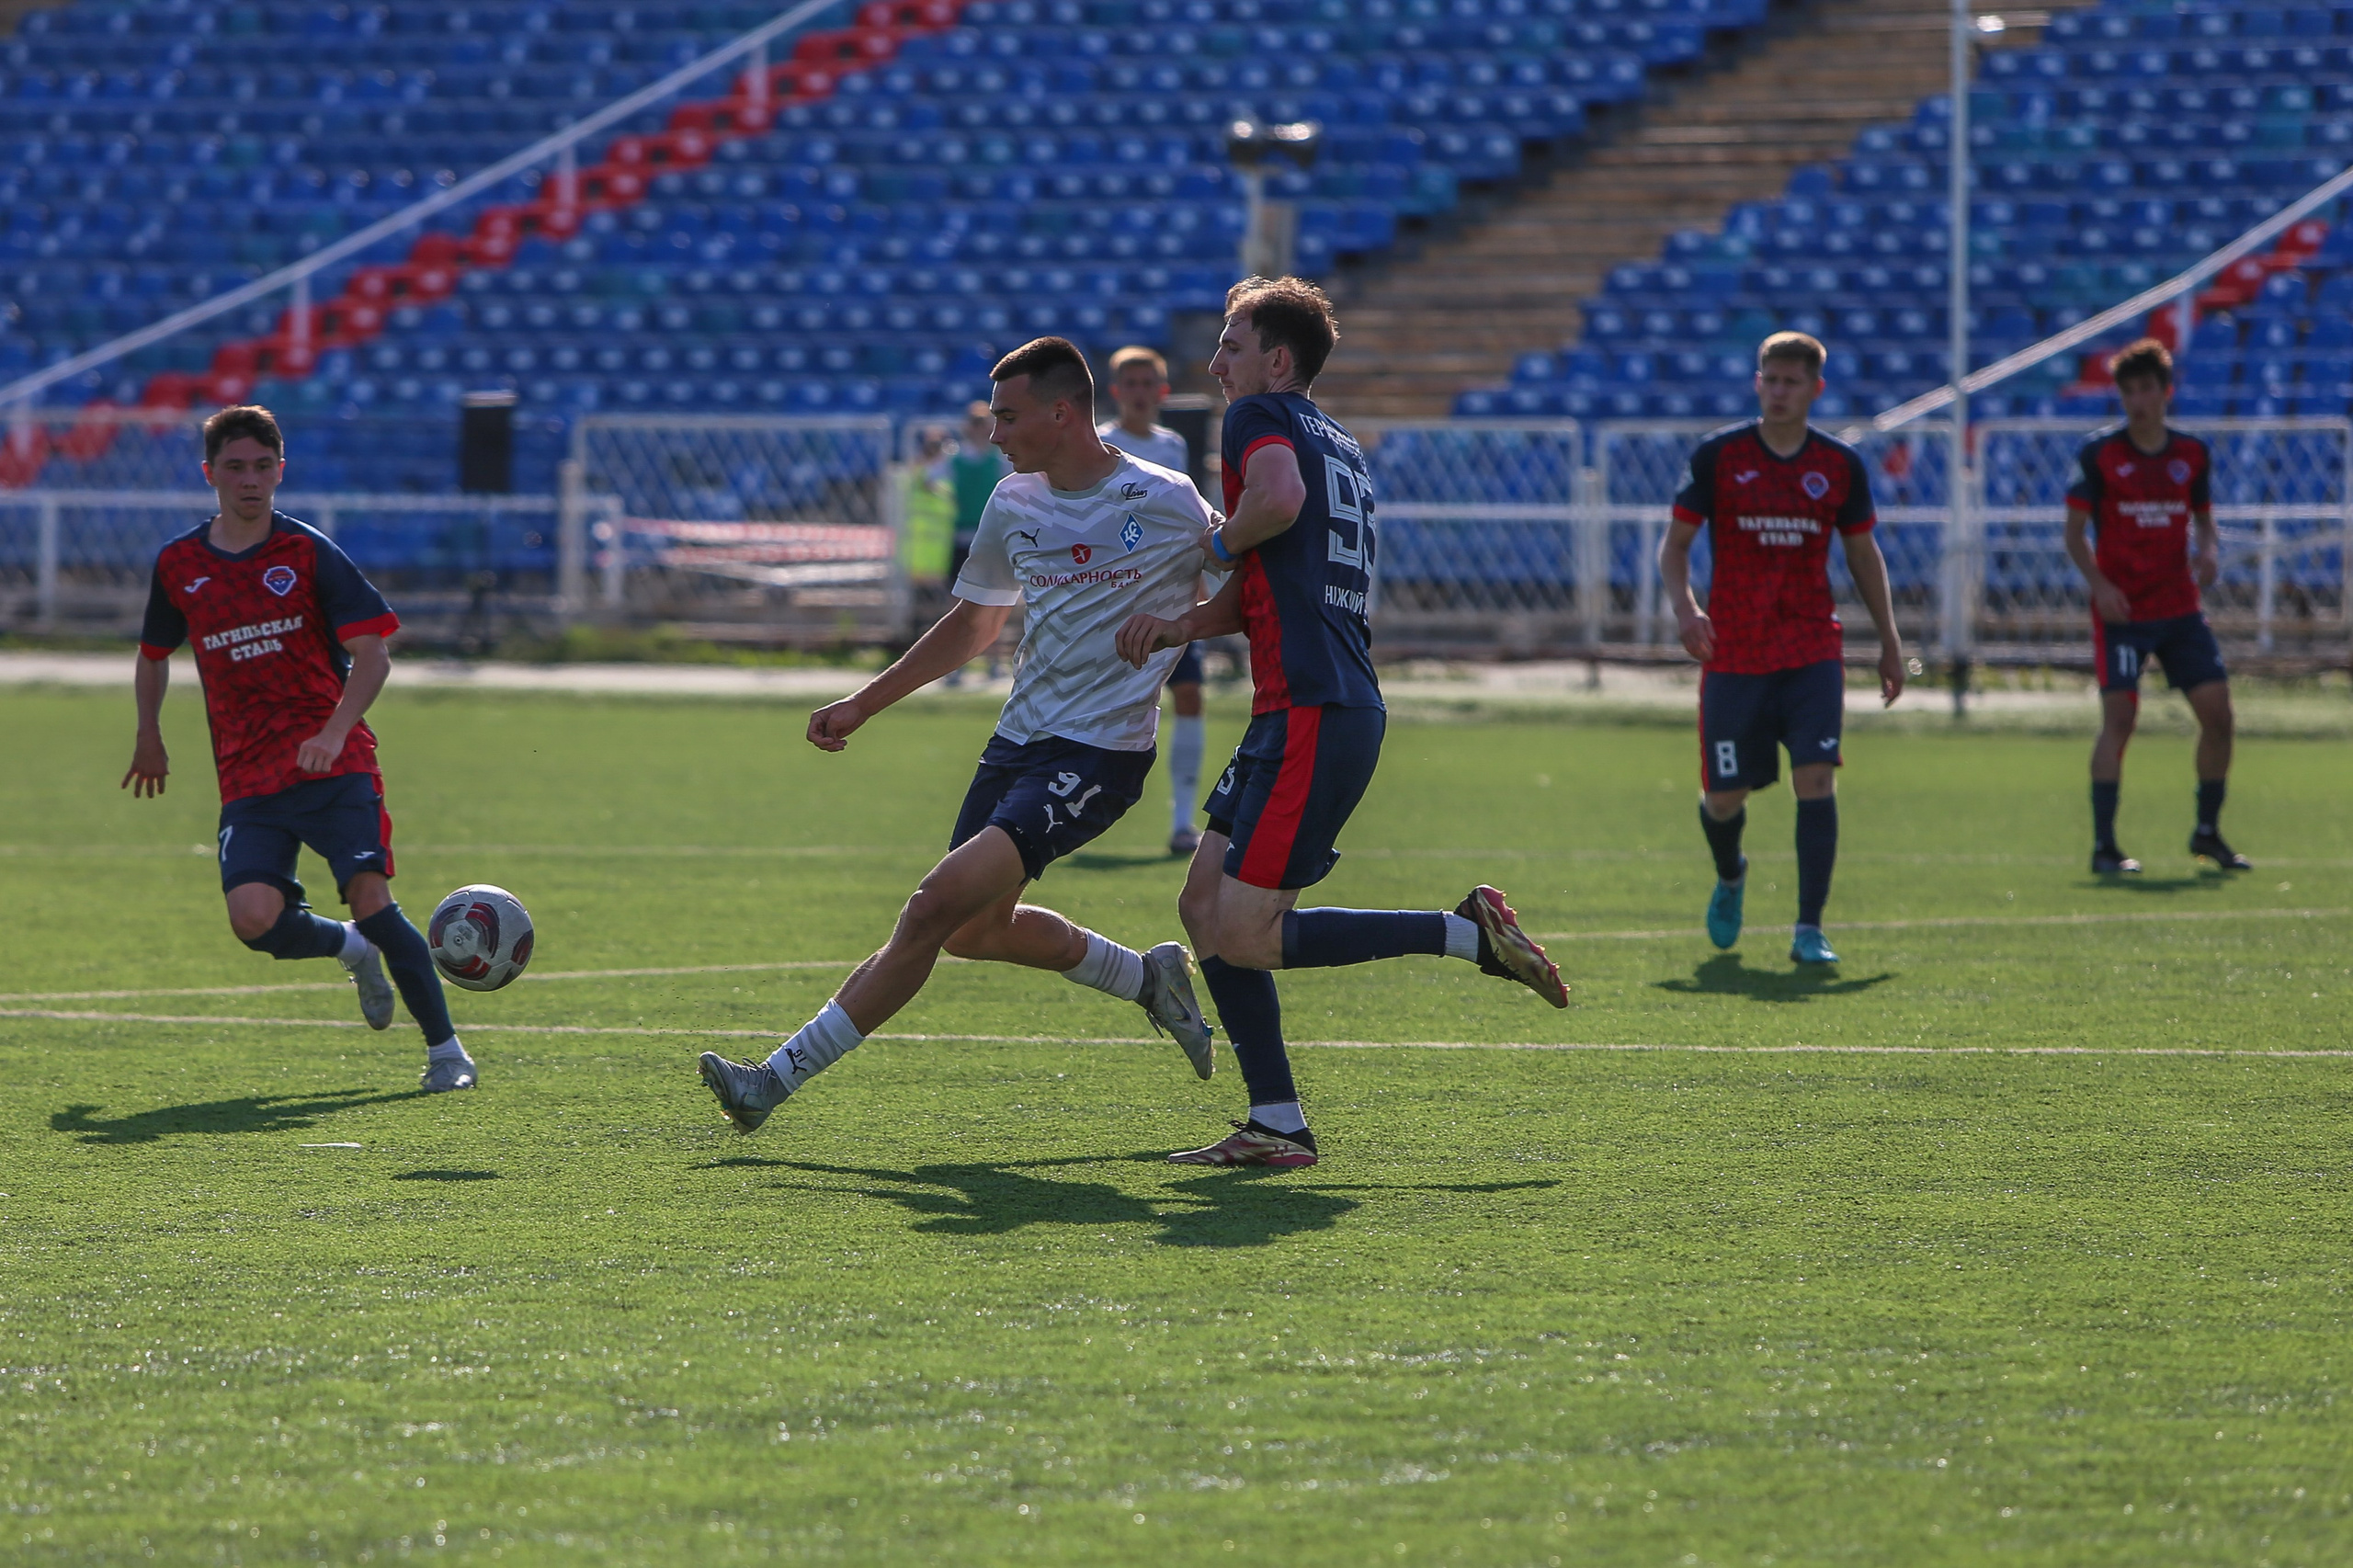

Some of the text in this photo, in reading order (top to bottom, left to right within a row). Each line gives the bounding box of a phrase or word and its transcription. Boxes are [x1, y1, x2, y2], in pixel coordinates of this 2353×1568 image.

[1736, 516, 1822, 535] ТАГИЛЬСКА
[230, 638, 283, 662] СТАЛЬ
[1715, 740, 1739, 778] 8
[1048, 771, 1102, 818] 91
[219, 824, 233, 862] 7
[793, 1049, 807, 1063] 91
